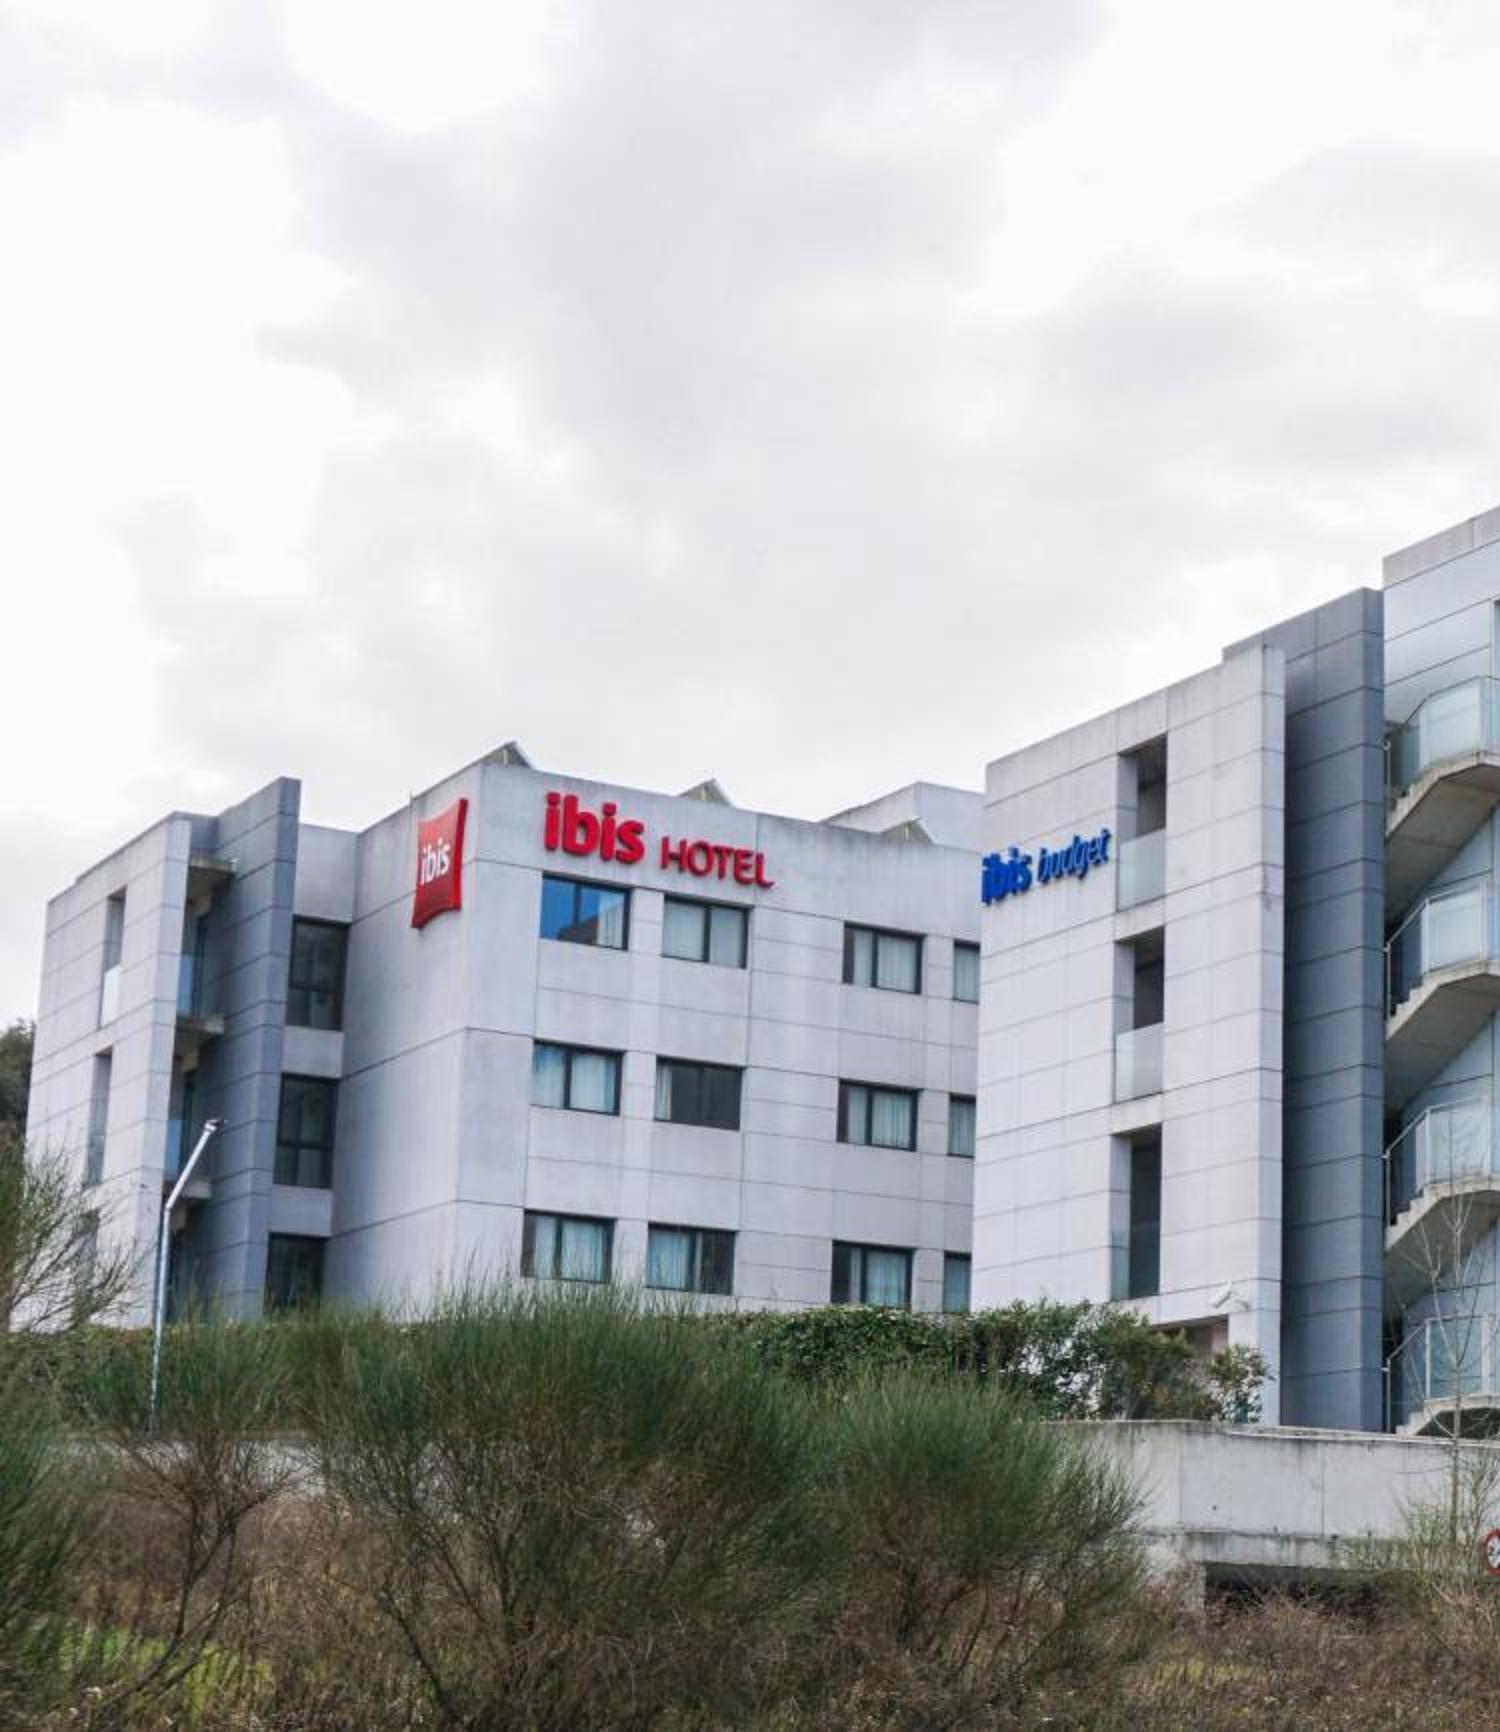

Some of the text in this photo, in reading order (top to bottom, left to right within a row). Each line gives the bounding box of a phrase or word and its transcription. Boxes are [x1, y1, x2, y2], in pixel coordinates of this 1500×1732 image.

[419, 837, 451, 886] ibis
[543, 791, 775, 889] ibis HOTEL
[981, 827, 1112, 906] ibis budget
